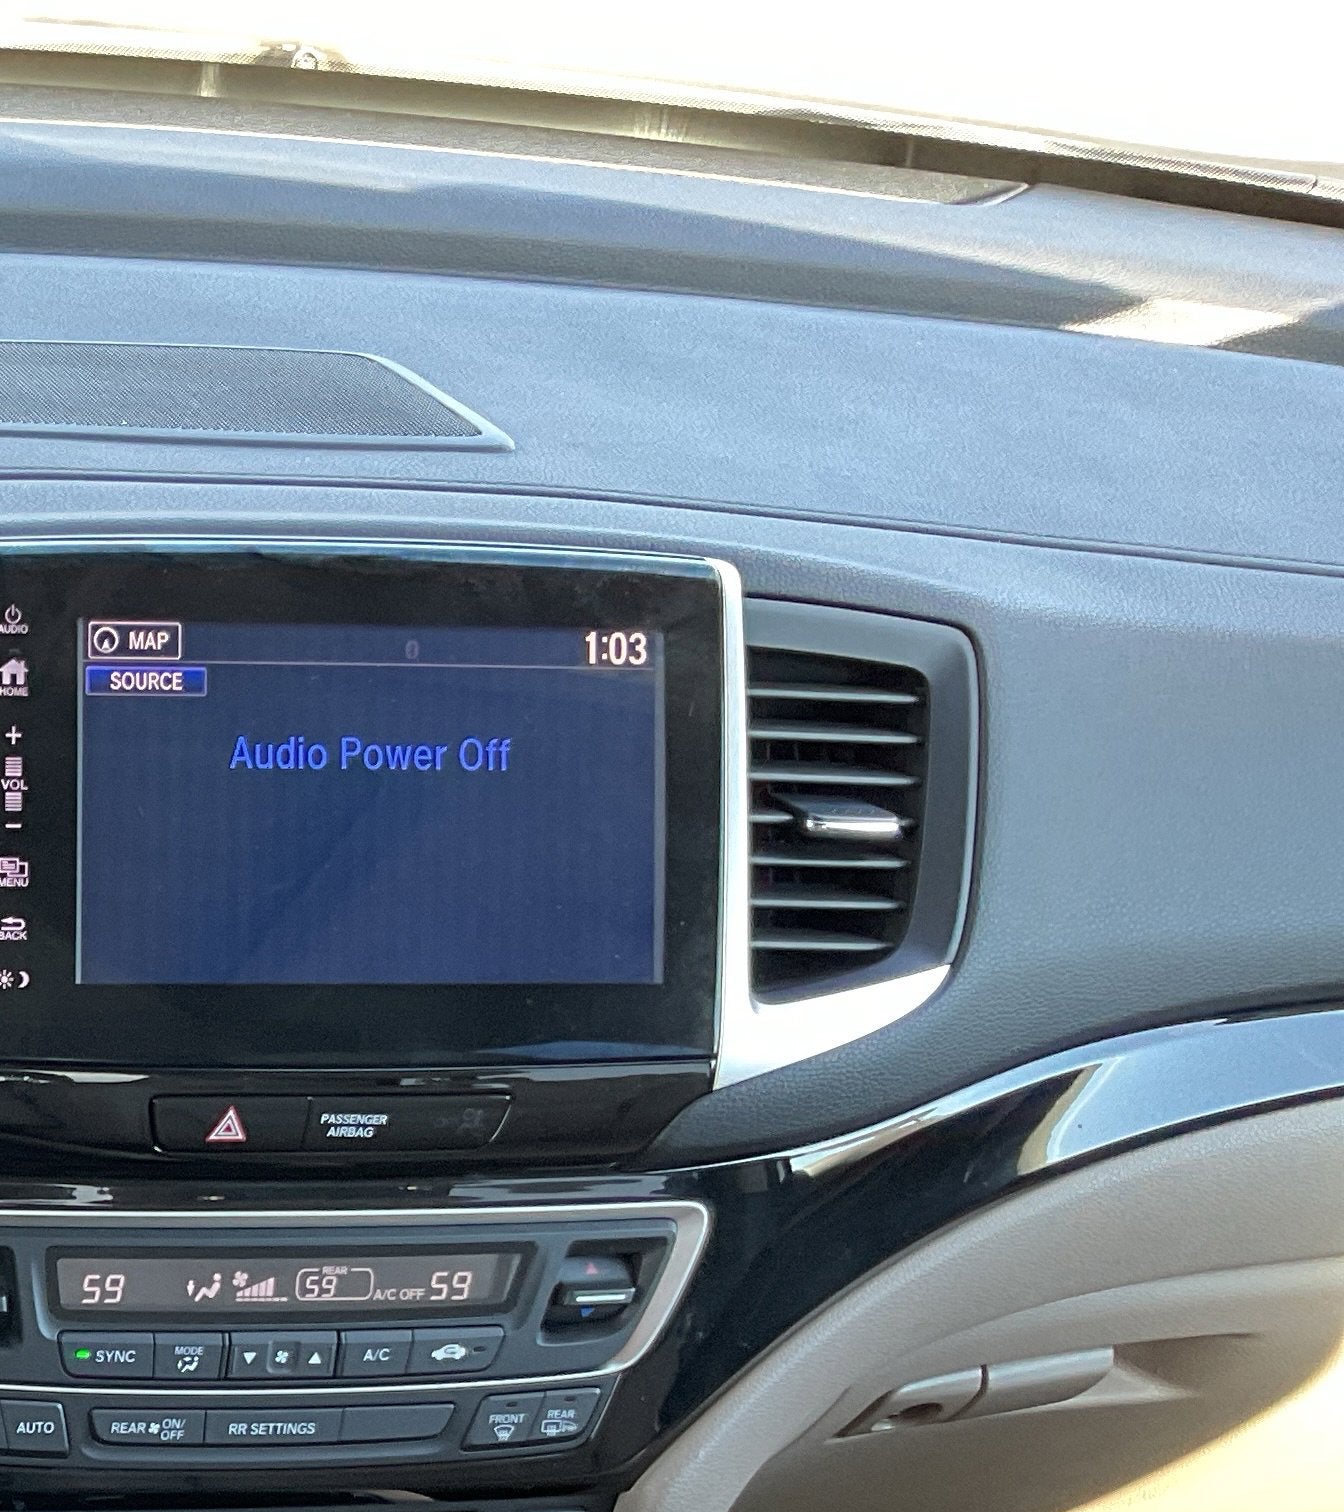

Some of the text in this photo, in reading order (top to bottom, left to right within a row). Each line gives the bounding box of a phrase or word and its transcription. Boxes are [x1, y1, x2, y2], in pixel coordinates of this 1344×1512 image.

[128, 631, 648, 666] MAP 1:03
[109, 671, 184, 691] SOURCE
[229, 735, 512, 772] Audio Power Off
[0, 779, 28, 791] VOL
[320, 1114, 388, 1125] PASSENGER
[326, 1126, 374, 1138] AIRBAG
[322, 1266, 348, 1275] REAR
[81, 1271, 473, 1304] 59 59 A/C OFF 59
[95, 1347, 391, 1363] SYNC A/C
[175, 1345, 204, 1356] MODE
[488, 1413, 526, 1424] FRONT
[546, 1409, 576, 1419] REAR
[16, 1421, 55, 1435] AUTO
[110, 1421, 146, 1435] REAR
[161, 1418, 187, 1430] ON/
[227, 1421, 316, 1436] RR SETTINGS
[159, 1429, 185, 1442] OFF
